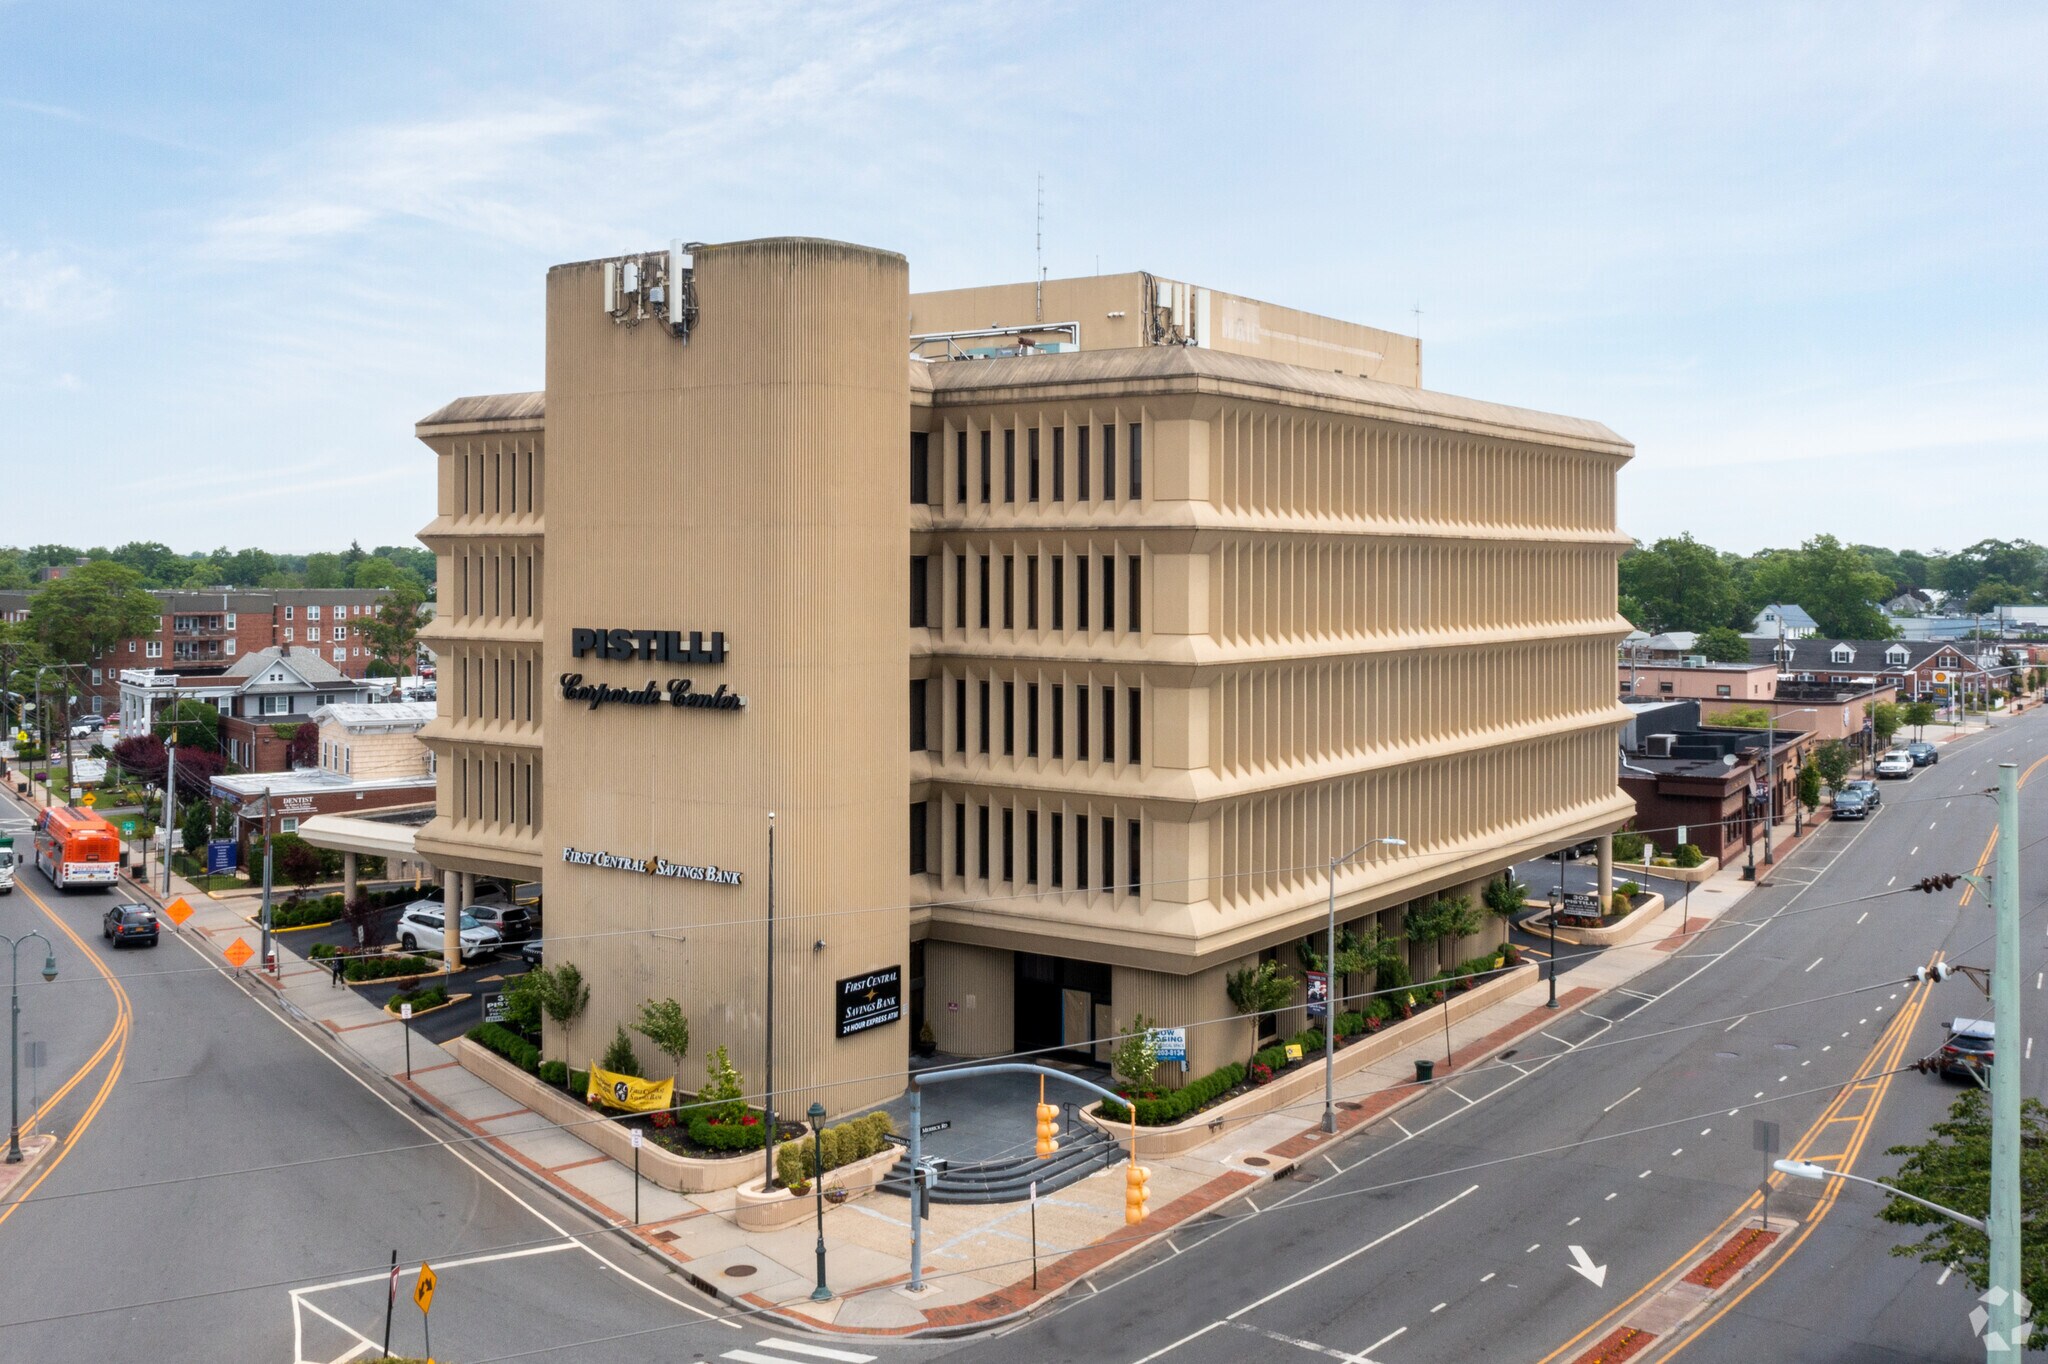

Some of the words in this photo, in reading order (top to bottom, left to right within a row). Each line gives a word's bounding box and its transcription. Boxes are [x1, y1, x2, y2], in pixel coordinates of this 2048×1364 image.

[572, 628, 724, 663] PISTILLI
[560, 673, 661, 710] Corporate
[667, 679, 741, 710] Center
[562, 847, 594, 865] FIRST
[595, 851, 646, 873] CENTRAL
[656, 859, 704, 880] SAVINGS
[705, 865, 741, 885] BANK
[844, 981, 866, 994] FIRST
[866, 972, 897, 988] CENTRAL
[846, 1002, 876, 1018] SAVINGS
[876, 997, 896, 1010] BANK
[843, 1026, 850, 1034] 24
[851, 1021, 865, 1031] HOUR
[866, 1014, 887, 1027] EXPRESS
[887, 1011, 898, 1020] ATM
